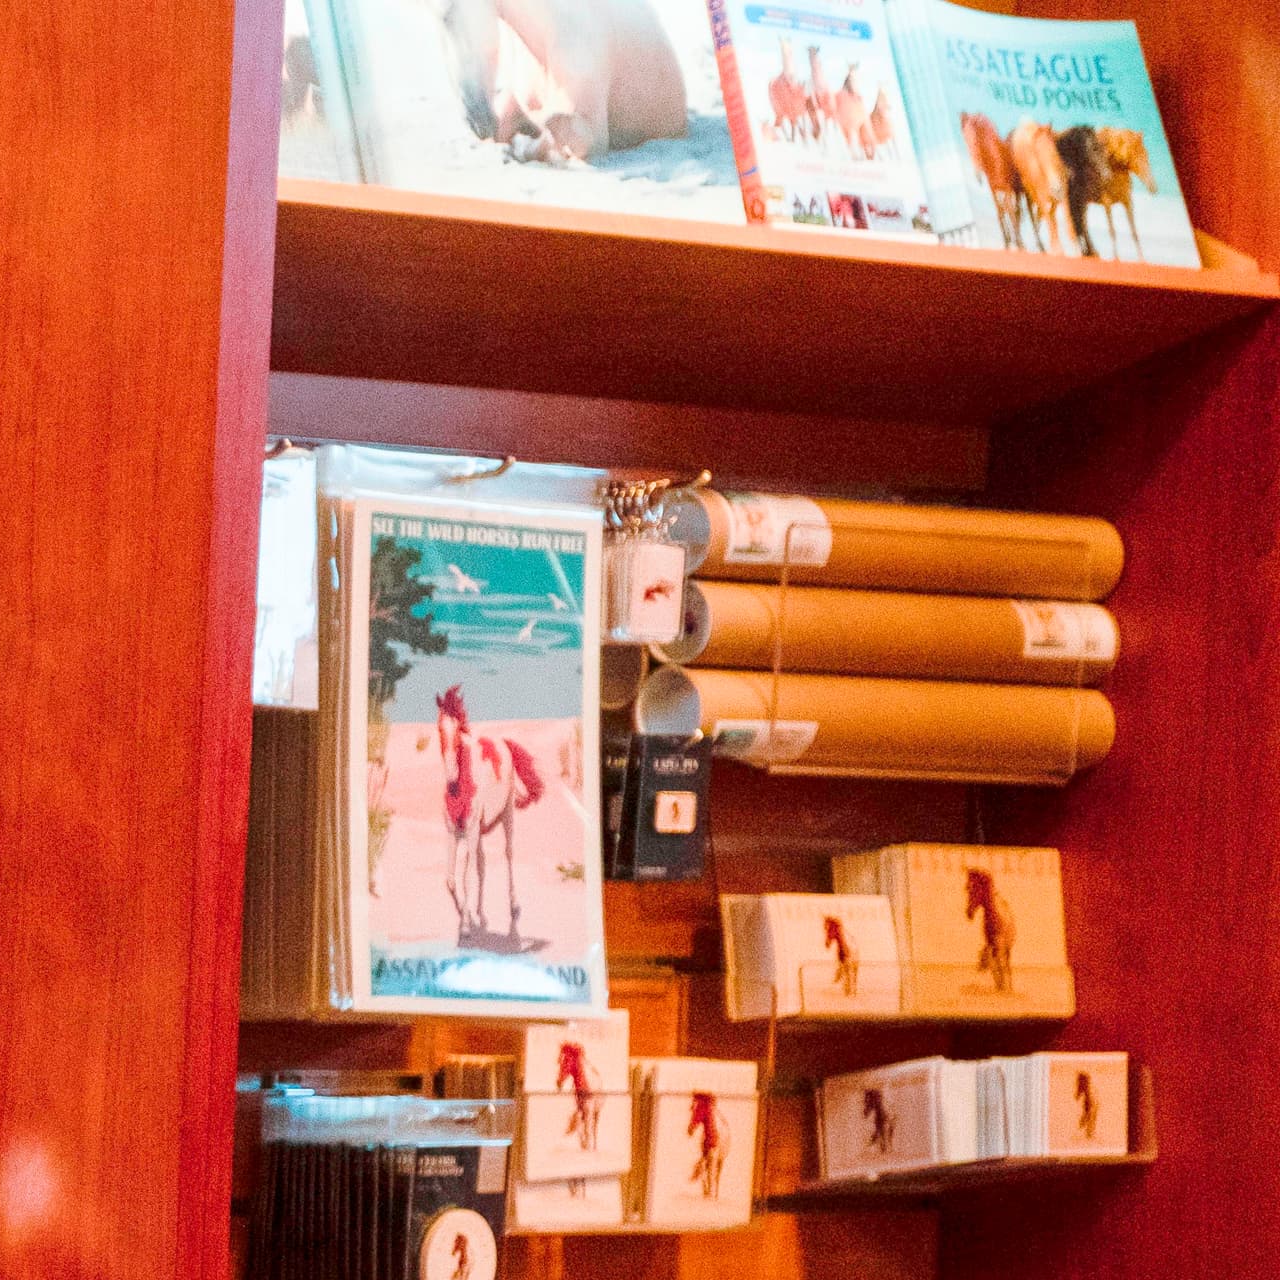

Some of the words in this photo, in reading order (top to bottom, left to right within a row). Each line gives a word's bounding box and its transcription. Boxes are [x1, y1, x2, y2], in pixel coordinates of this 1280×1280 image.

[946, 40, 1113, 85] ASSATEAGUE
[989, 82, 1035, 106] WILD
[428, 523, 464, 540] WILD
